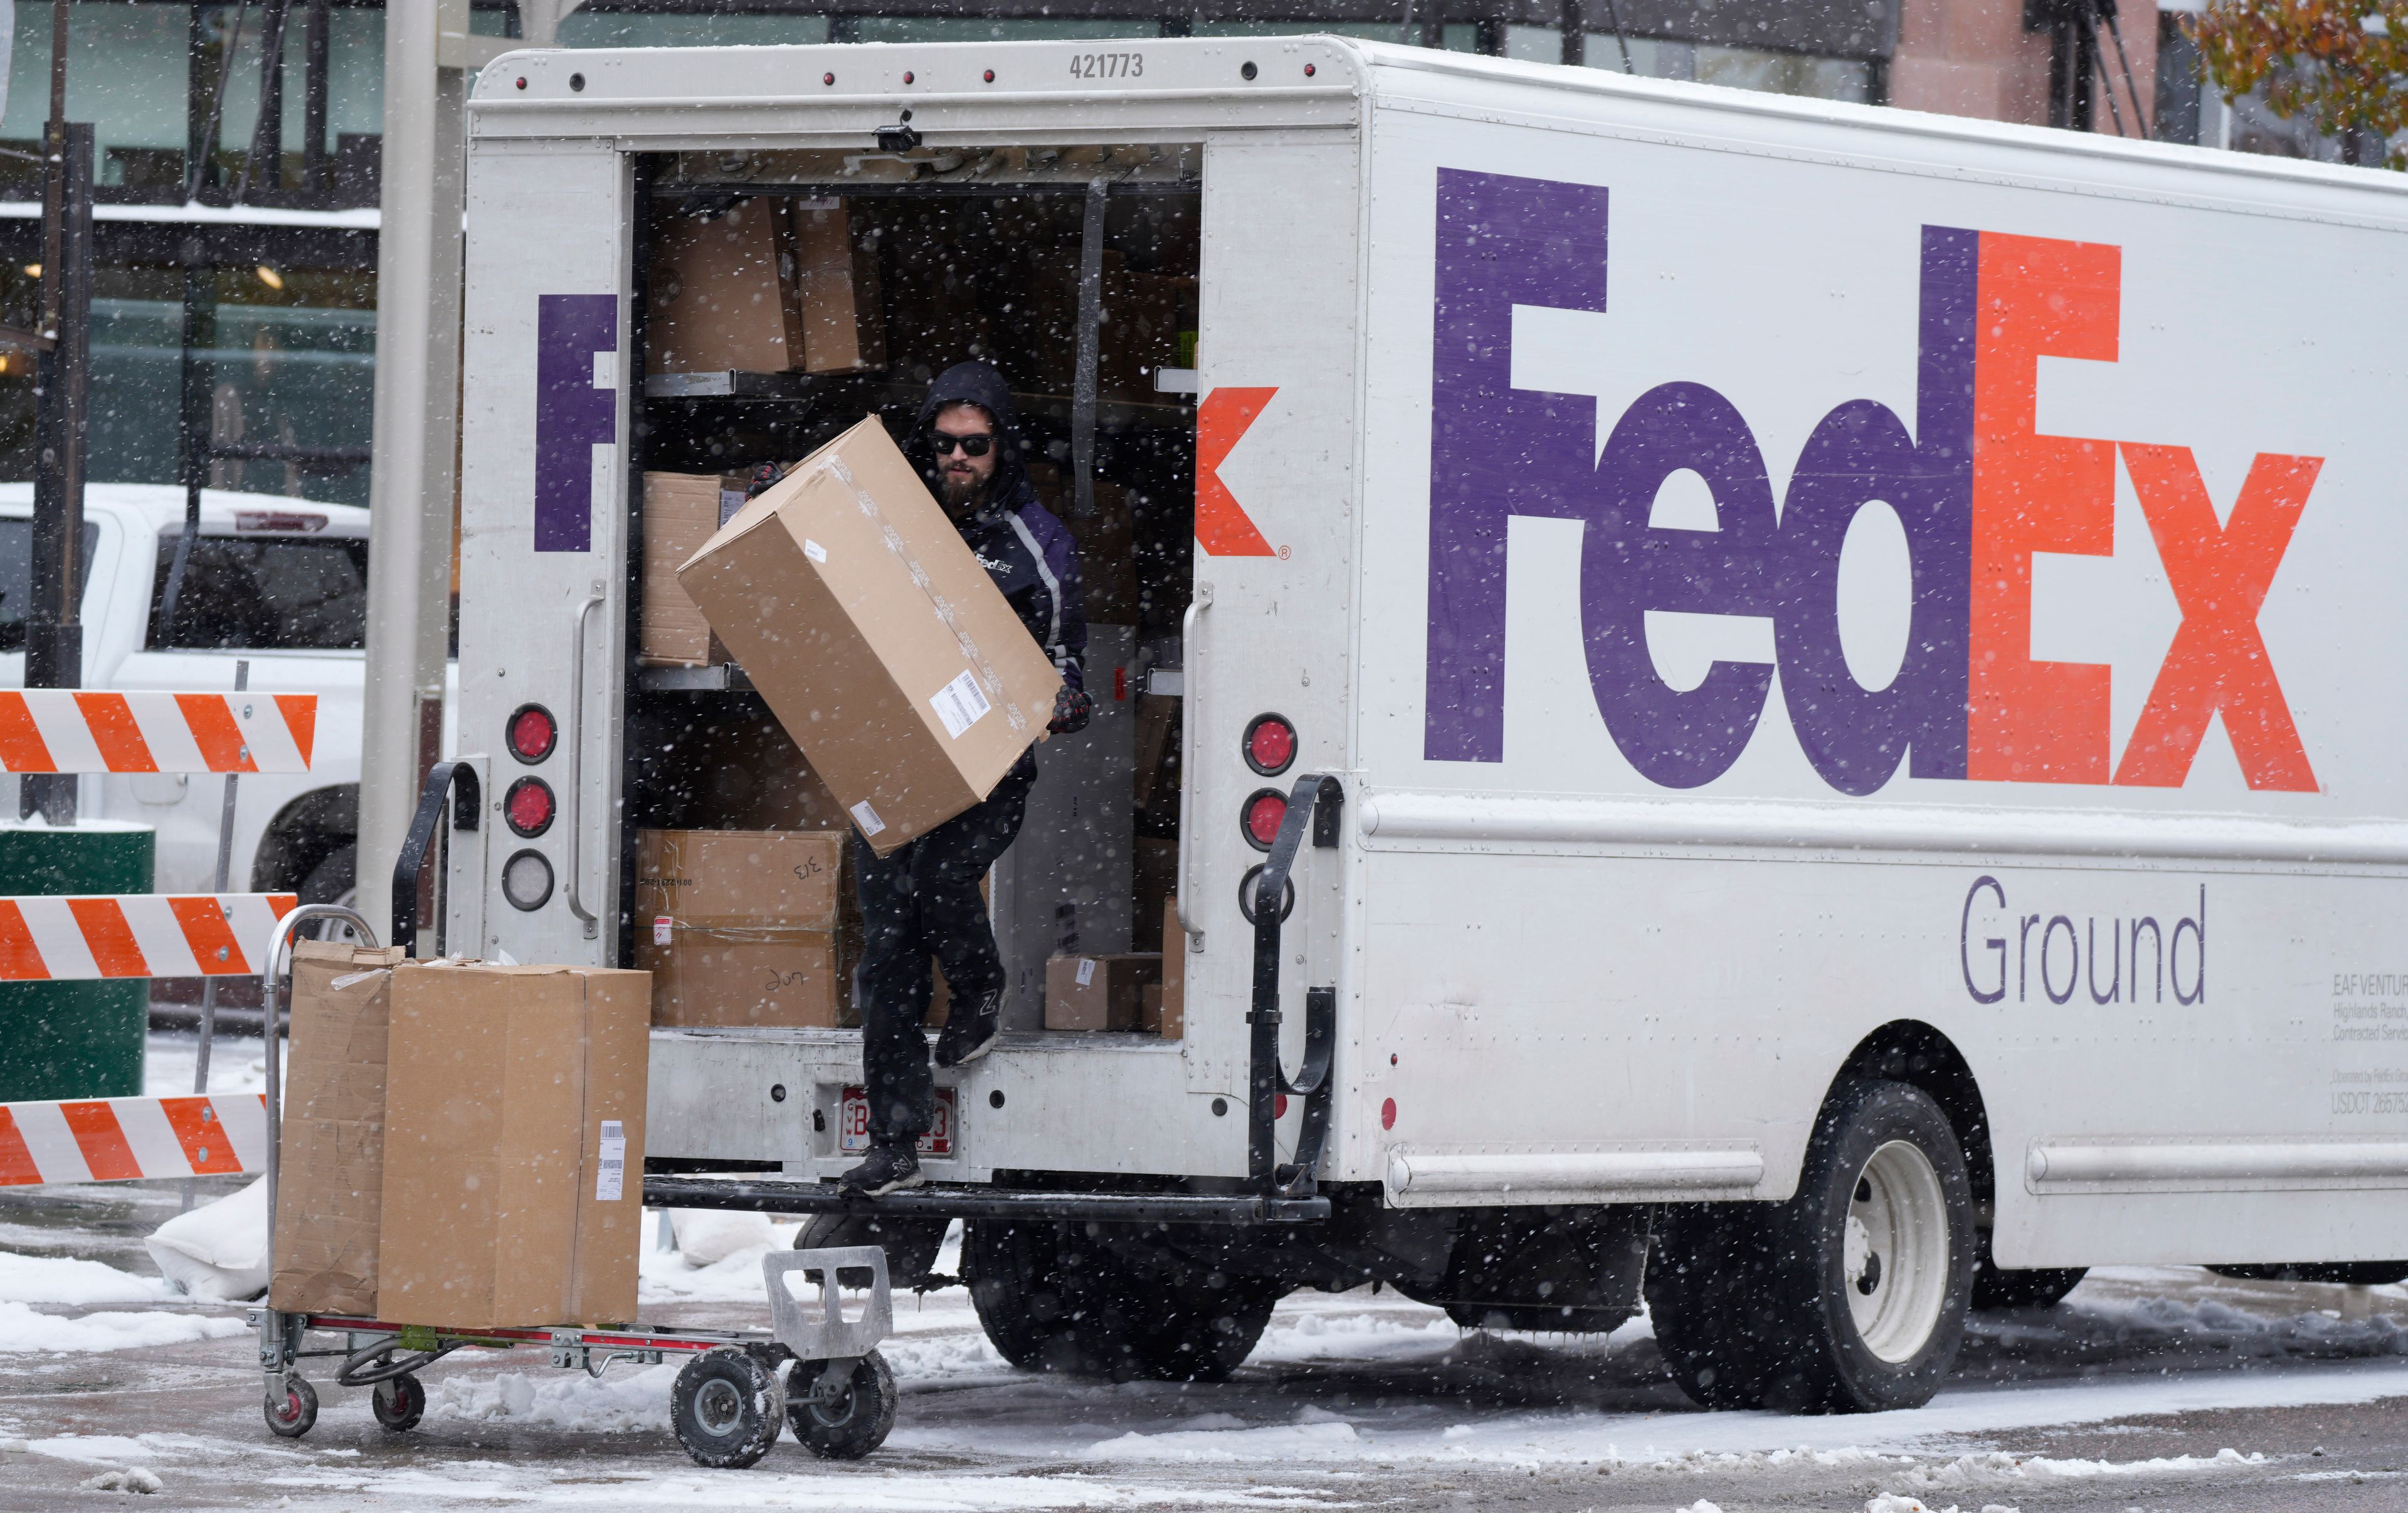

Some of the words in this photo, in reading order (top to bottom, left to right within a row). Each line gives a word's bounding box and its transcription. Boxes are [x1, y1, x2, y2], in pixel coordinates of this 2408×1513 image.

[1070, 53, 1143, 78] 421773
[1423, 166, 2326, 796] FedEx
[1961, 875, 2205, 1006] Ground
[2334, 974, 2358, 996] EAF
[2333, 1002, 2378, 1023] Highlands
[2333, 1024, 2380, 1041] Contracted
